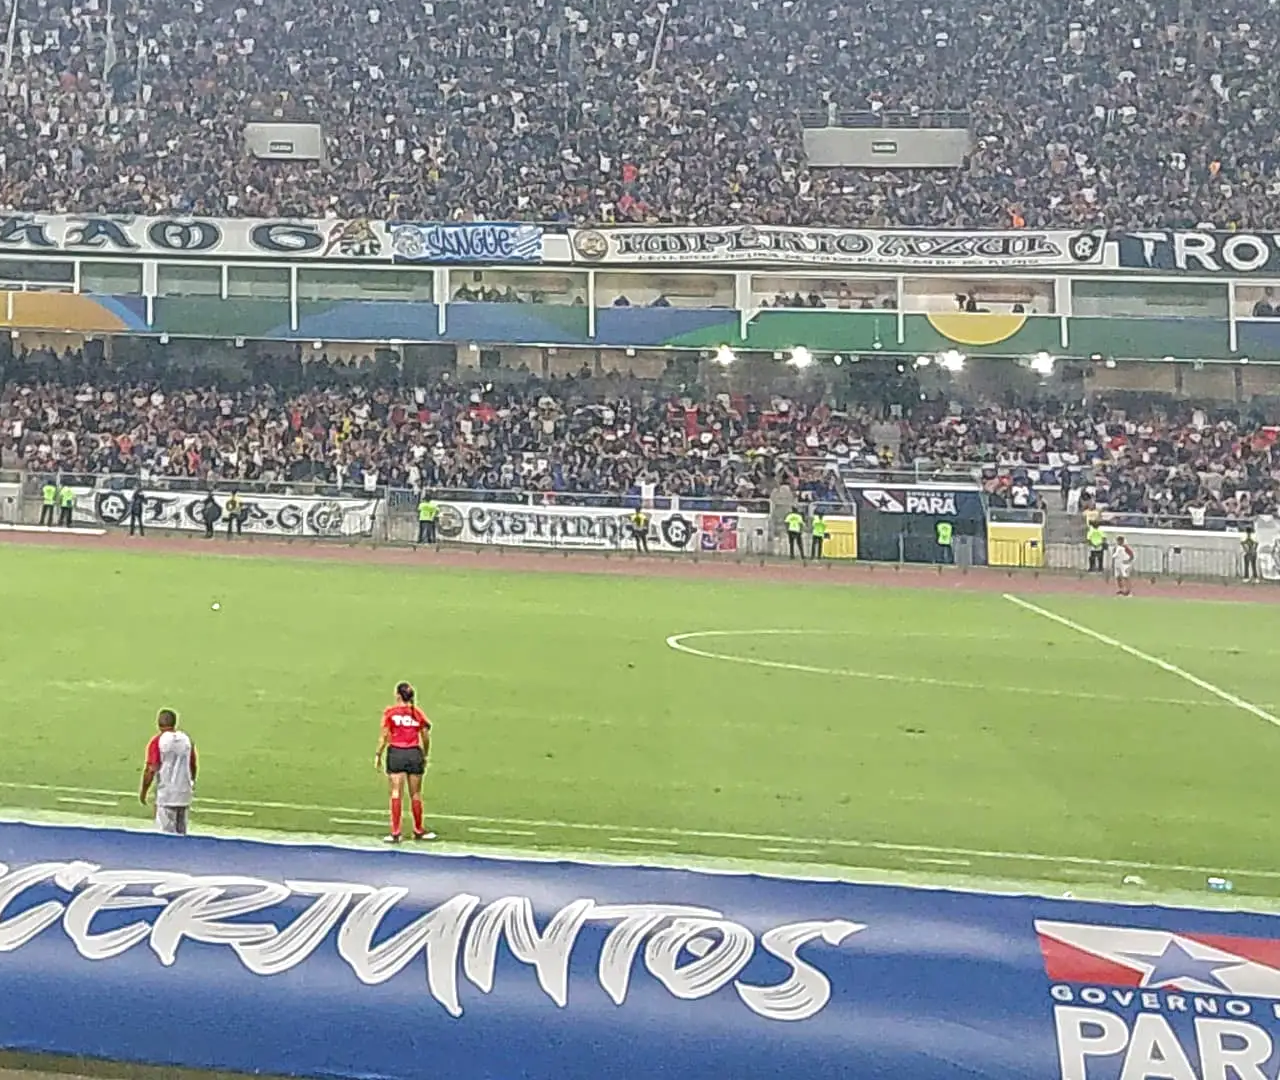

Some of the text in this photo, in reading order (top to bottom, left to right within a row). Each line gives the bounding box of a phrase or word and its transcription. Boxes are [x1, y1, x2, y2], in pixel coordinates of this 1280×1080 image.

[878, 233, 1059, 258] AZUL
[1125, 232, 1280, 272] TRO
[906, 495, 958, 516] PARÁ
[1050, 984, 1251, 1016] GOVERNO
[1054, 1004, 1280, 1080] PAR
